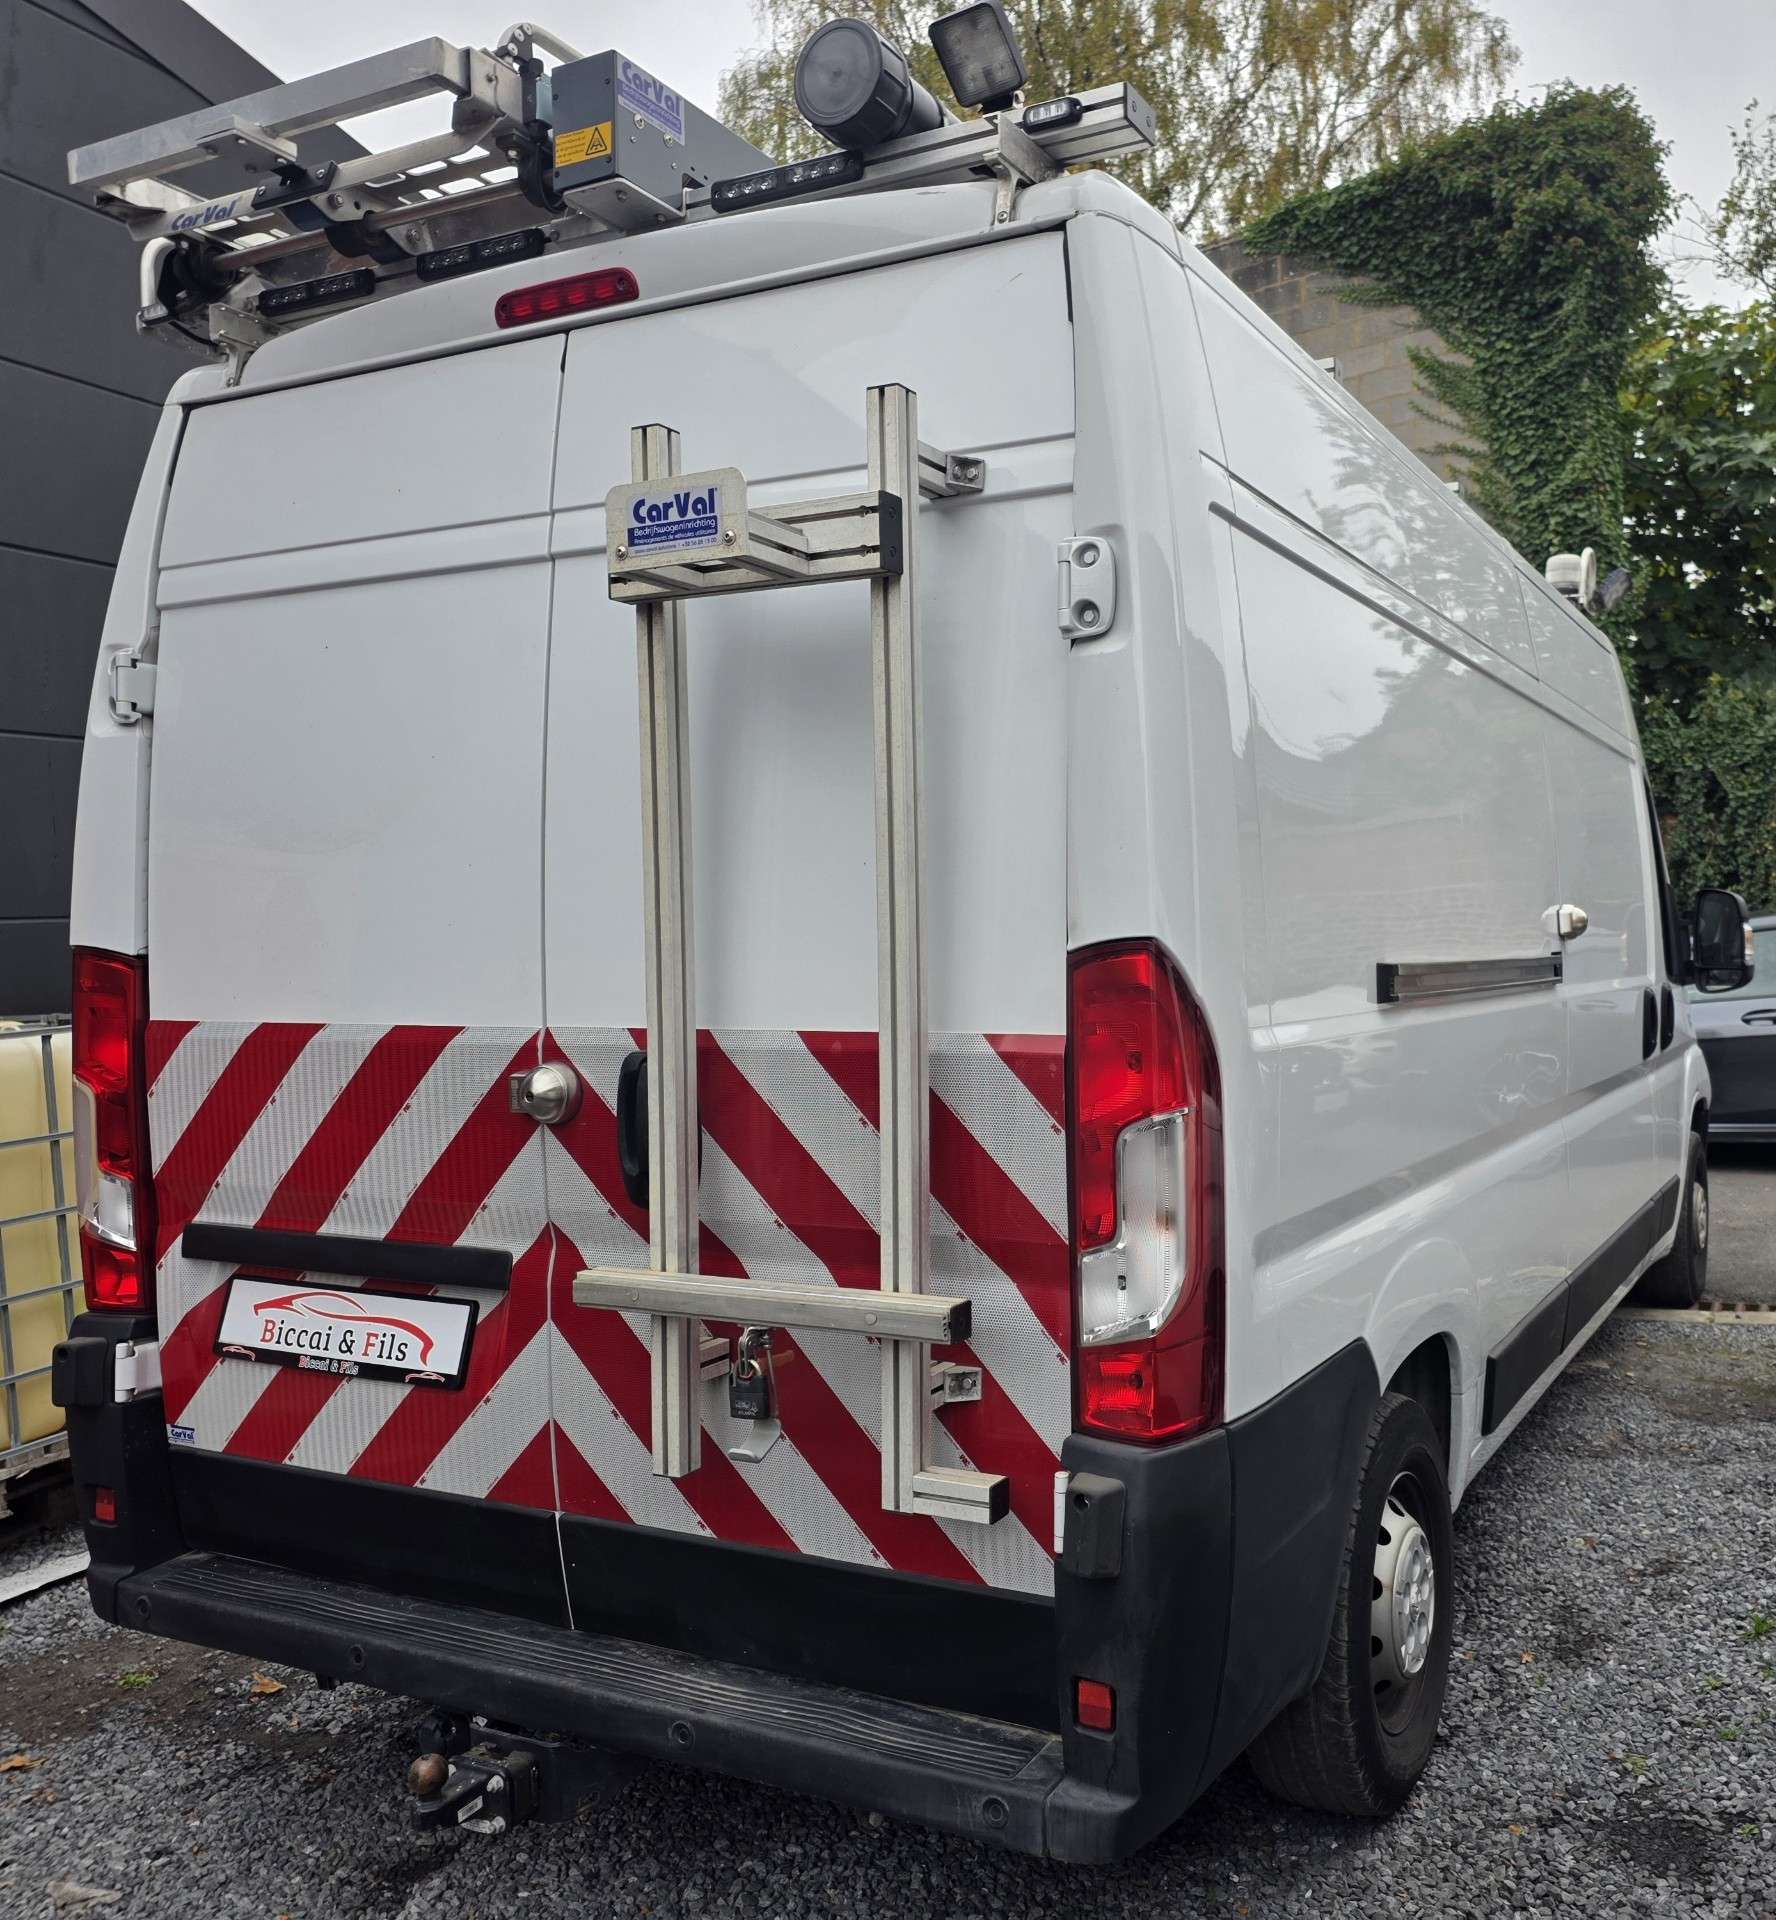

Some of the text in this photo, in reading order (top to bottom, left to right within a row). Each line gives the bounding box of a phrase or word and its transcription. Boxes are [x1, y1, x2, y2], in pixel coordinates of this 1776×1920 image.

[622, 61, 680, 116] CarVal
[172, 200, 236, 230] CarVal
[633, 487, 715, 524] CarVal
[633, 518, 716, 536] Bedrijfswageninrichting
[260, 1318, 409, 1362] Biccai & Fils
[298, 1356, 359, 1376] Biccai & Fils
